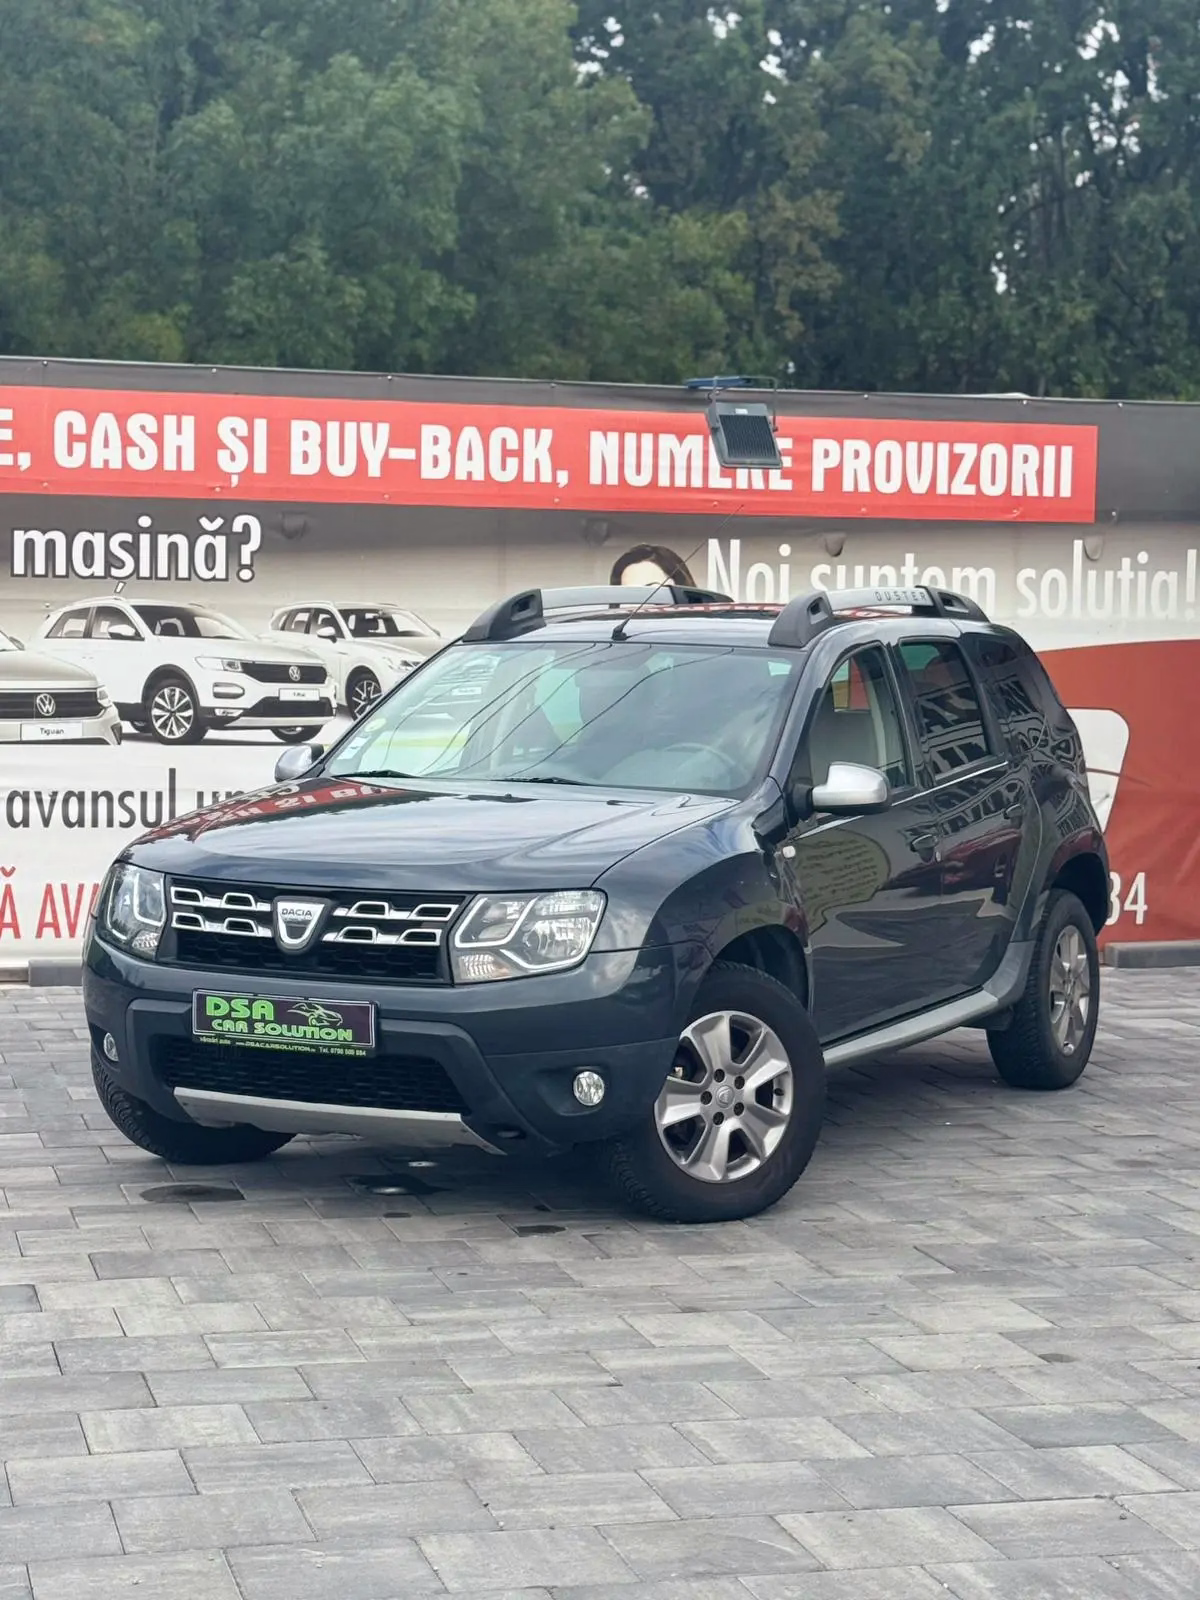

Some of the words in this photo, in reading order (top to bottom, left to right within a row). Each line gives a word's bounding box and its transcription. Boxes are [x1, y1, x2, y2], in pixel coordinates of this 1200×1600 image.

[53, 410, 195, 472] CASH
[216, 415, 267, 488] ȘI
[290, 419, 569, 489] BUY-BACK,
[811, 437, 1073, 498] PROVIZORII
[707, 538, 792, 602] Noi
[874, 590, 927, 602] DUSTER
[6, 768, 176, 829] avansul
[282, 908, 312, 918] DACIA
[206, 996, 274, 1021] DSA
[211, 1019, 248, 1033] CAR
[254, 1022, 353, 1041] SOLUTION
